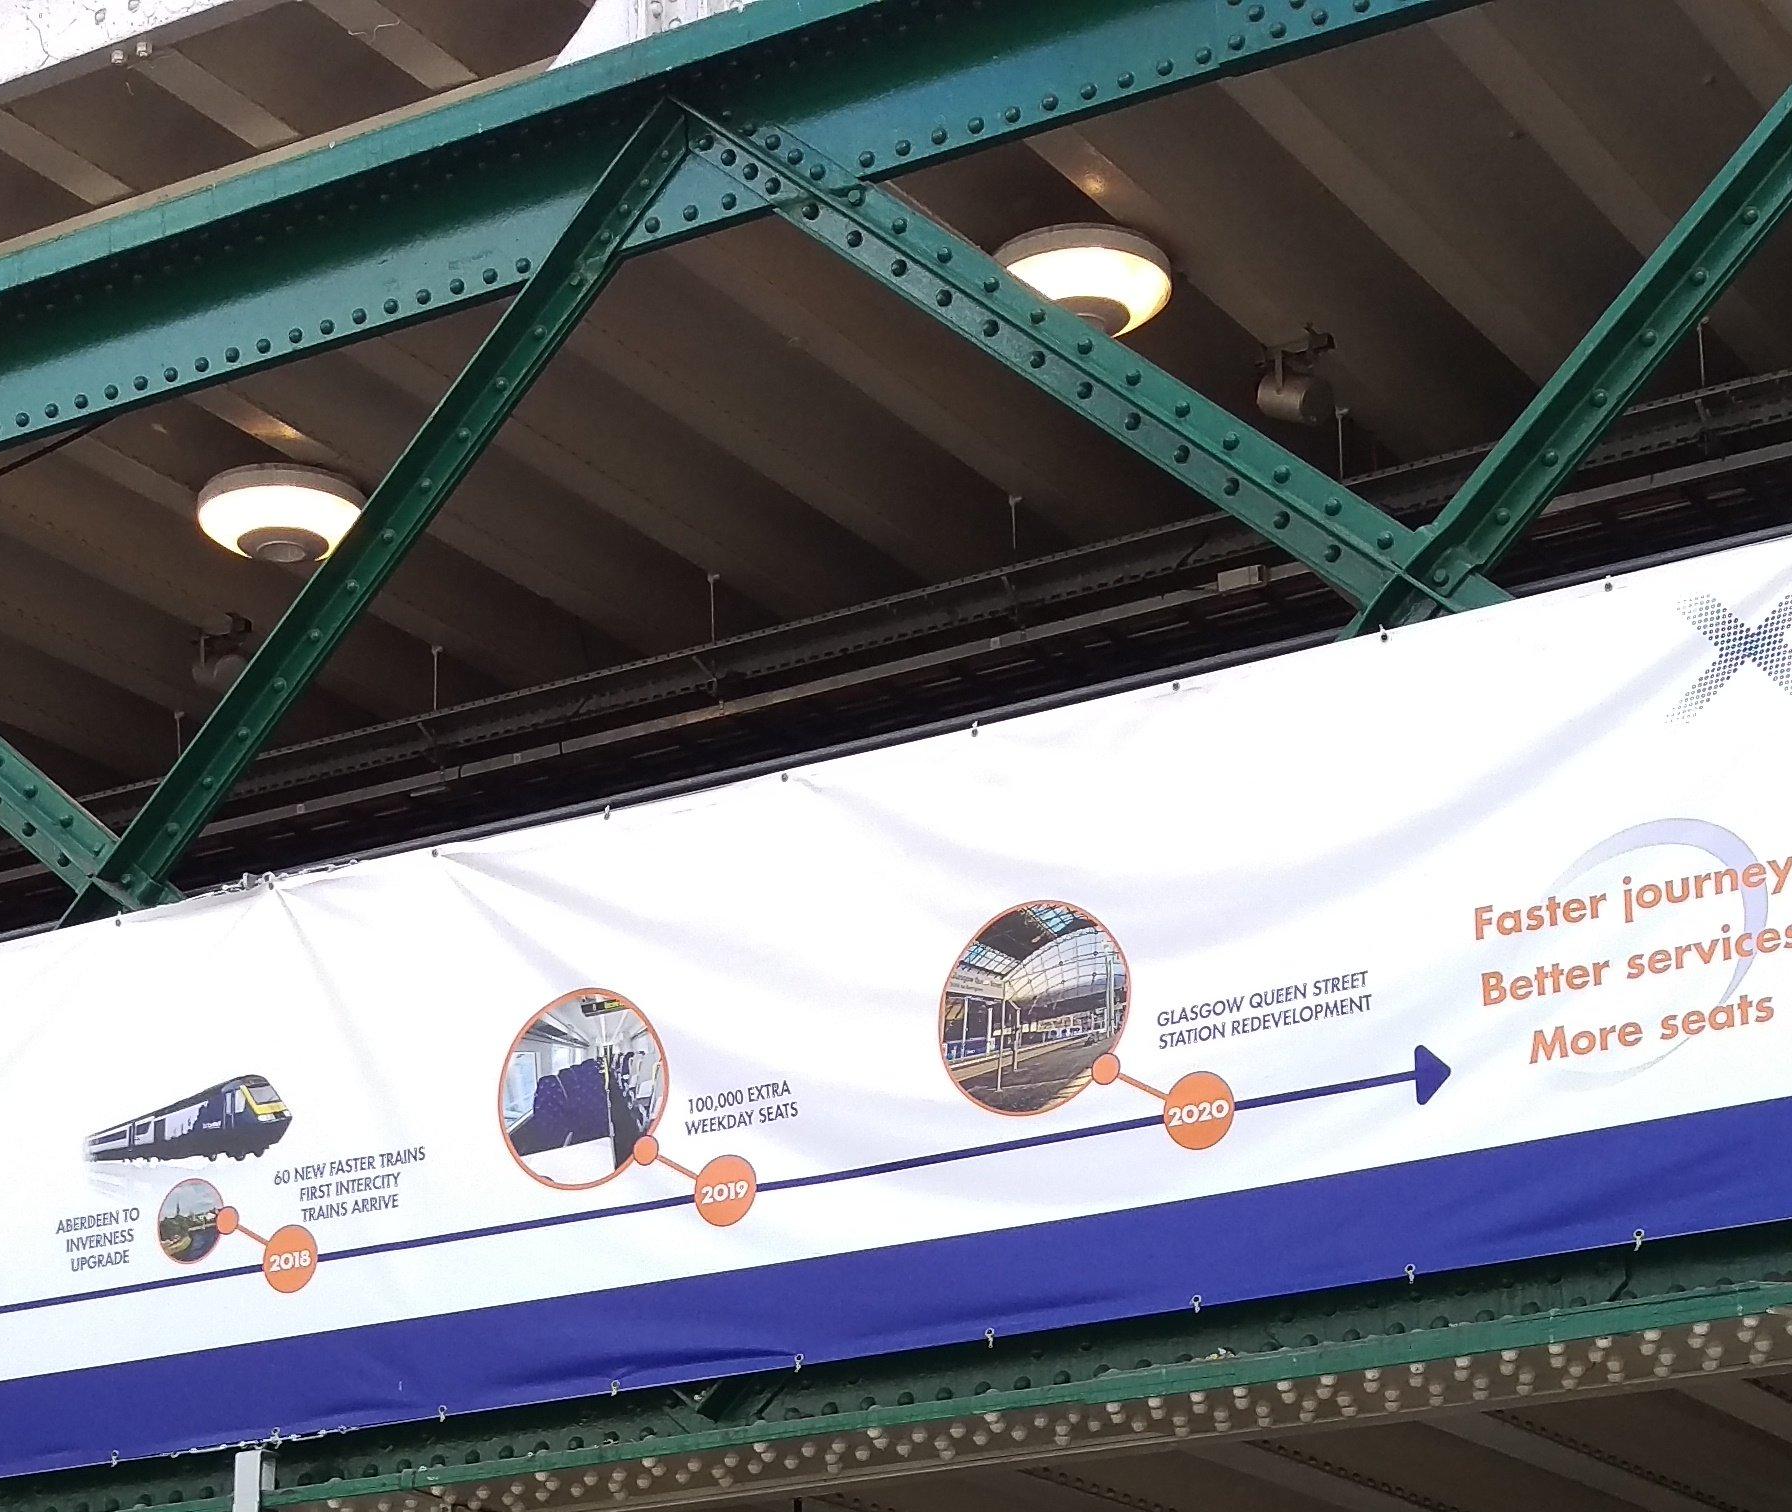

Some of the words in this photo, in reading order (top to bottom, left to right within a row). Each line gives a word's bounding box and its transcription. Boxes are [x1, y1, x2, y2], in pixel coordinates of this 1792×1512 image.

[1474, 890, 1607, 940] Faster
[1481, 959, 1611, 1006] Better
[1156, 995, 1245, 1028] GLASGOW
[1249, 983, 1308, 1014] QUEEN
[1312, 970, 1369, 1000] STREET
[1159, 1018, 1226, 1050] STATION
[1230, 993, 1373, 1038] REDEVELOPMENT
[1528, 1015, 1643, 1064] More
[1659, 992, 1775, 1042] seats
[687, 1089, 744, 1115] 100,000
[748, 1079, 791, 1102] EXTRA
[1167, 1100, 1230, 1126] 2020
[685, 1110, 754, 1136] WEEKDAY
[758, 1101, 798, 1124] SEATS
[273, 1168, 291, 1186] 60
[294, 1163, 327, 1183] NEW
[329, 1155, 377, 1177] FASTER
[379, 1146, 426, 1171] TRAINS
[299, 1181, 332, 1202] FIRST
[335, 1172, 402, 1198] INTERCITY
[701, 1180, 749, 1205] 2019
[55, 1209, 120, 1236] ABERDEEN
[122, 1206, 141, 1224] TO
[301, 1202, 349, 1223] TRAINS
[351, 1194, 400, 1216] ARRIVE
[65, 1228, 135, 1254] INVERNESS
[70, 1249, 130, 1273] UPGRADE
[269, 1250, 312, 1272] 2018
